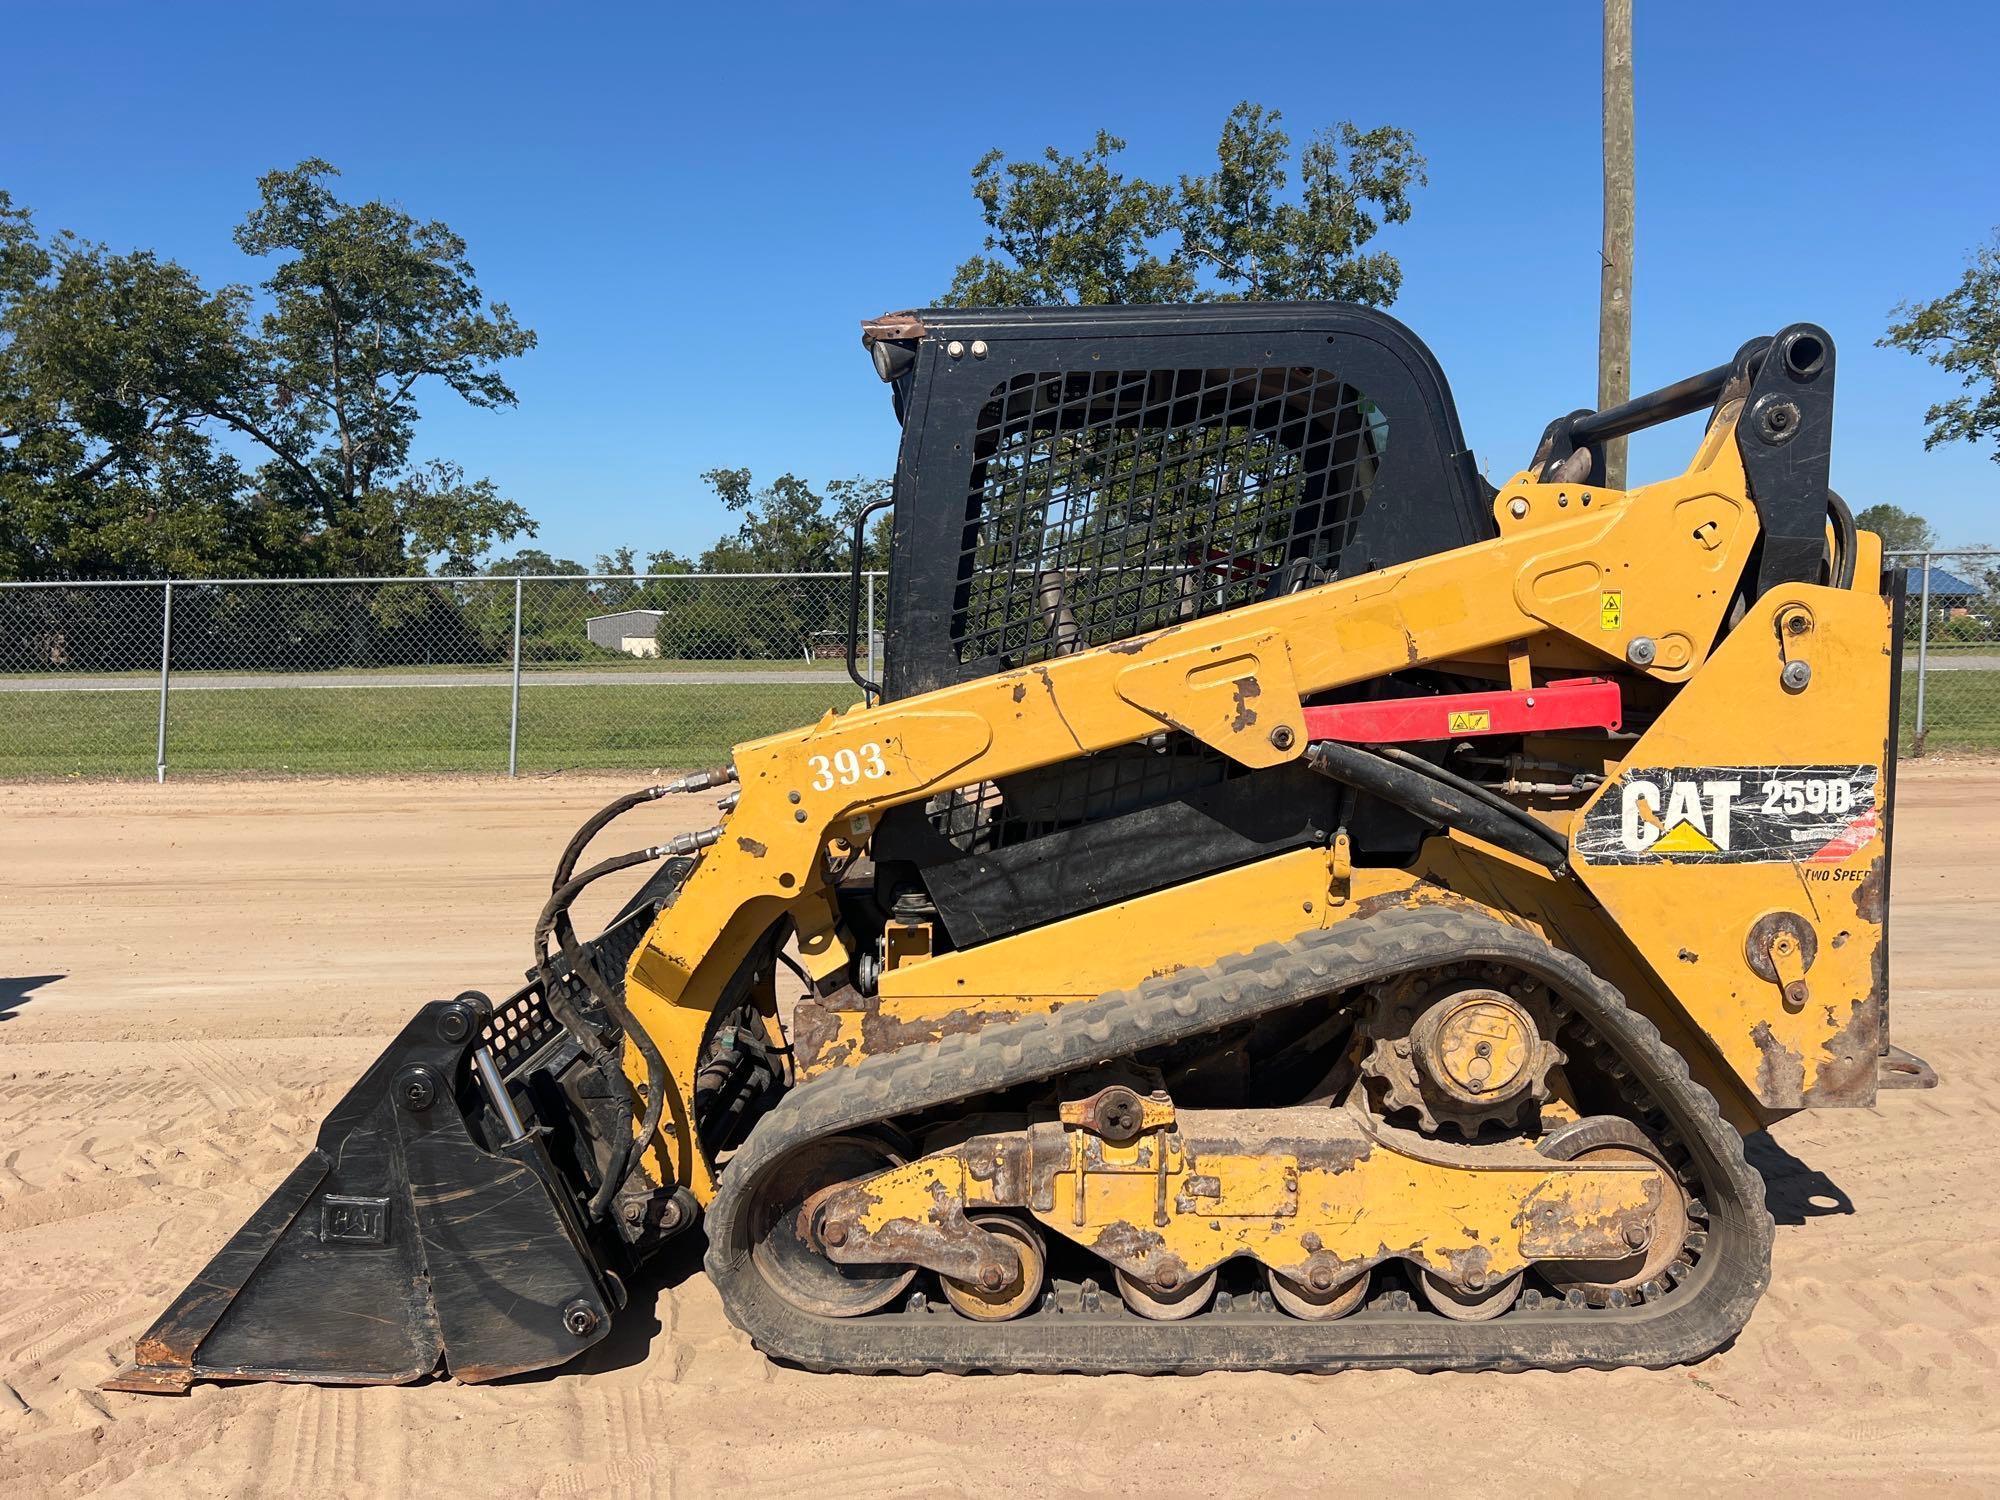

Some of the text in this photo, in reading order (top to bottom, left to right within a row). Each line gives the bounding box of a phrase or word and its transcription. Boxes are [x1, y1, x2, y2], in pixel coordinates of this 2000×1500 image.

[808, 742, 886, 791] 393
[1621, 779, 1851, 852] CAT 259D
[1805, 868, 1830, 881] TWO
